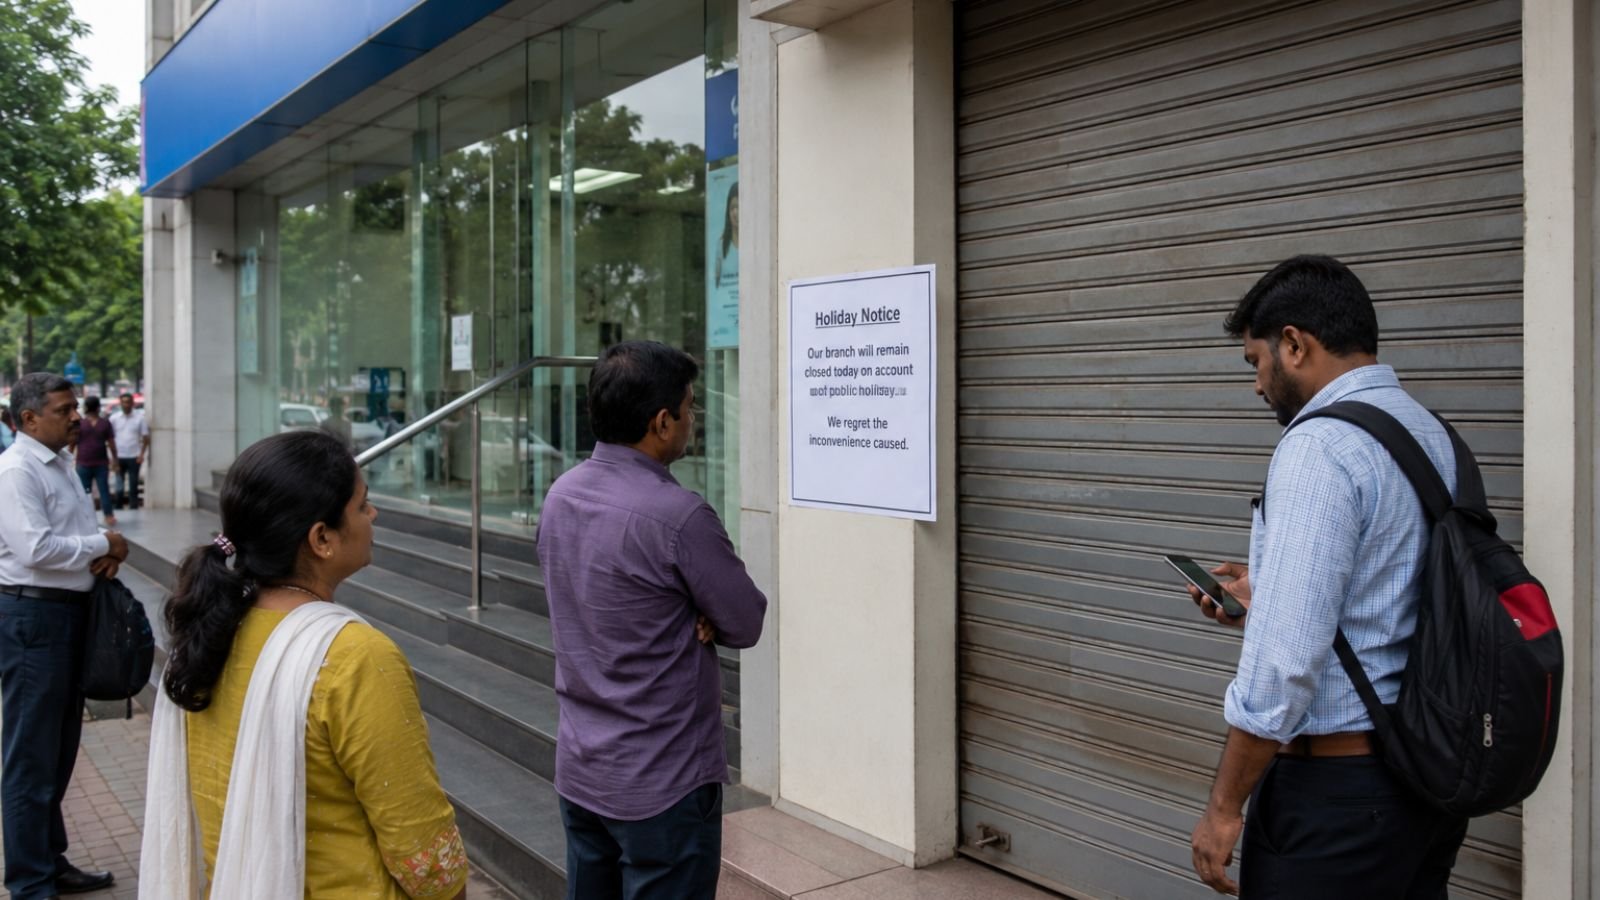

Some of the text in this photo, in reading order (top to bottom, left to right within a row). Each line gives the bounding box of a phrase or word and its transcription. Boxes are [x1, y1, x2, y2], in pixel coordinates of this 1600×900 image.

[815, 306, 901, 328] Holiday Notice
[807, 342, 910, 359] Our branch will remain
[804, 363, 914, 379] closed today on account
[827, 415, 889, 432] We regret the
[809, 433, 909, 451] inconvenience caused.
